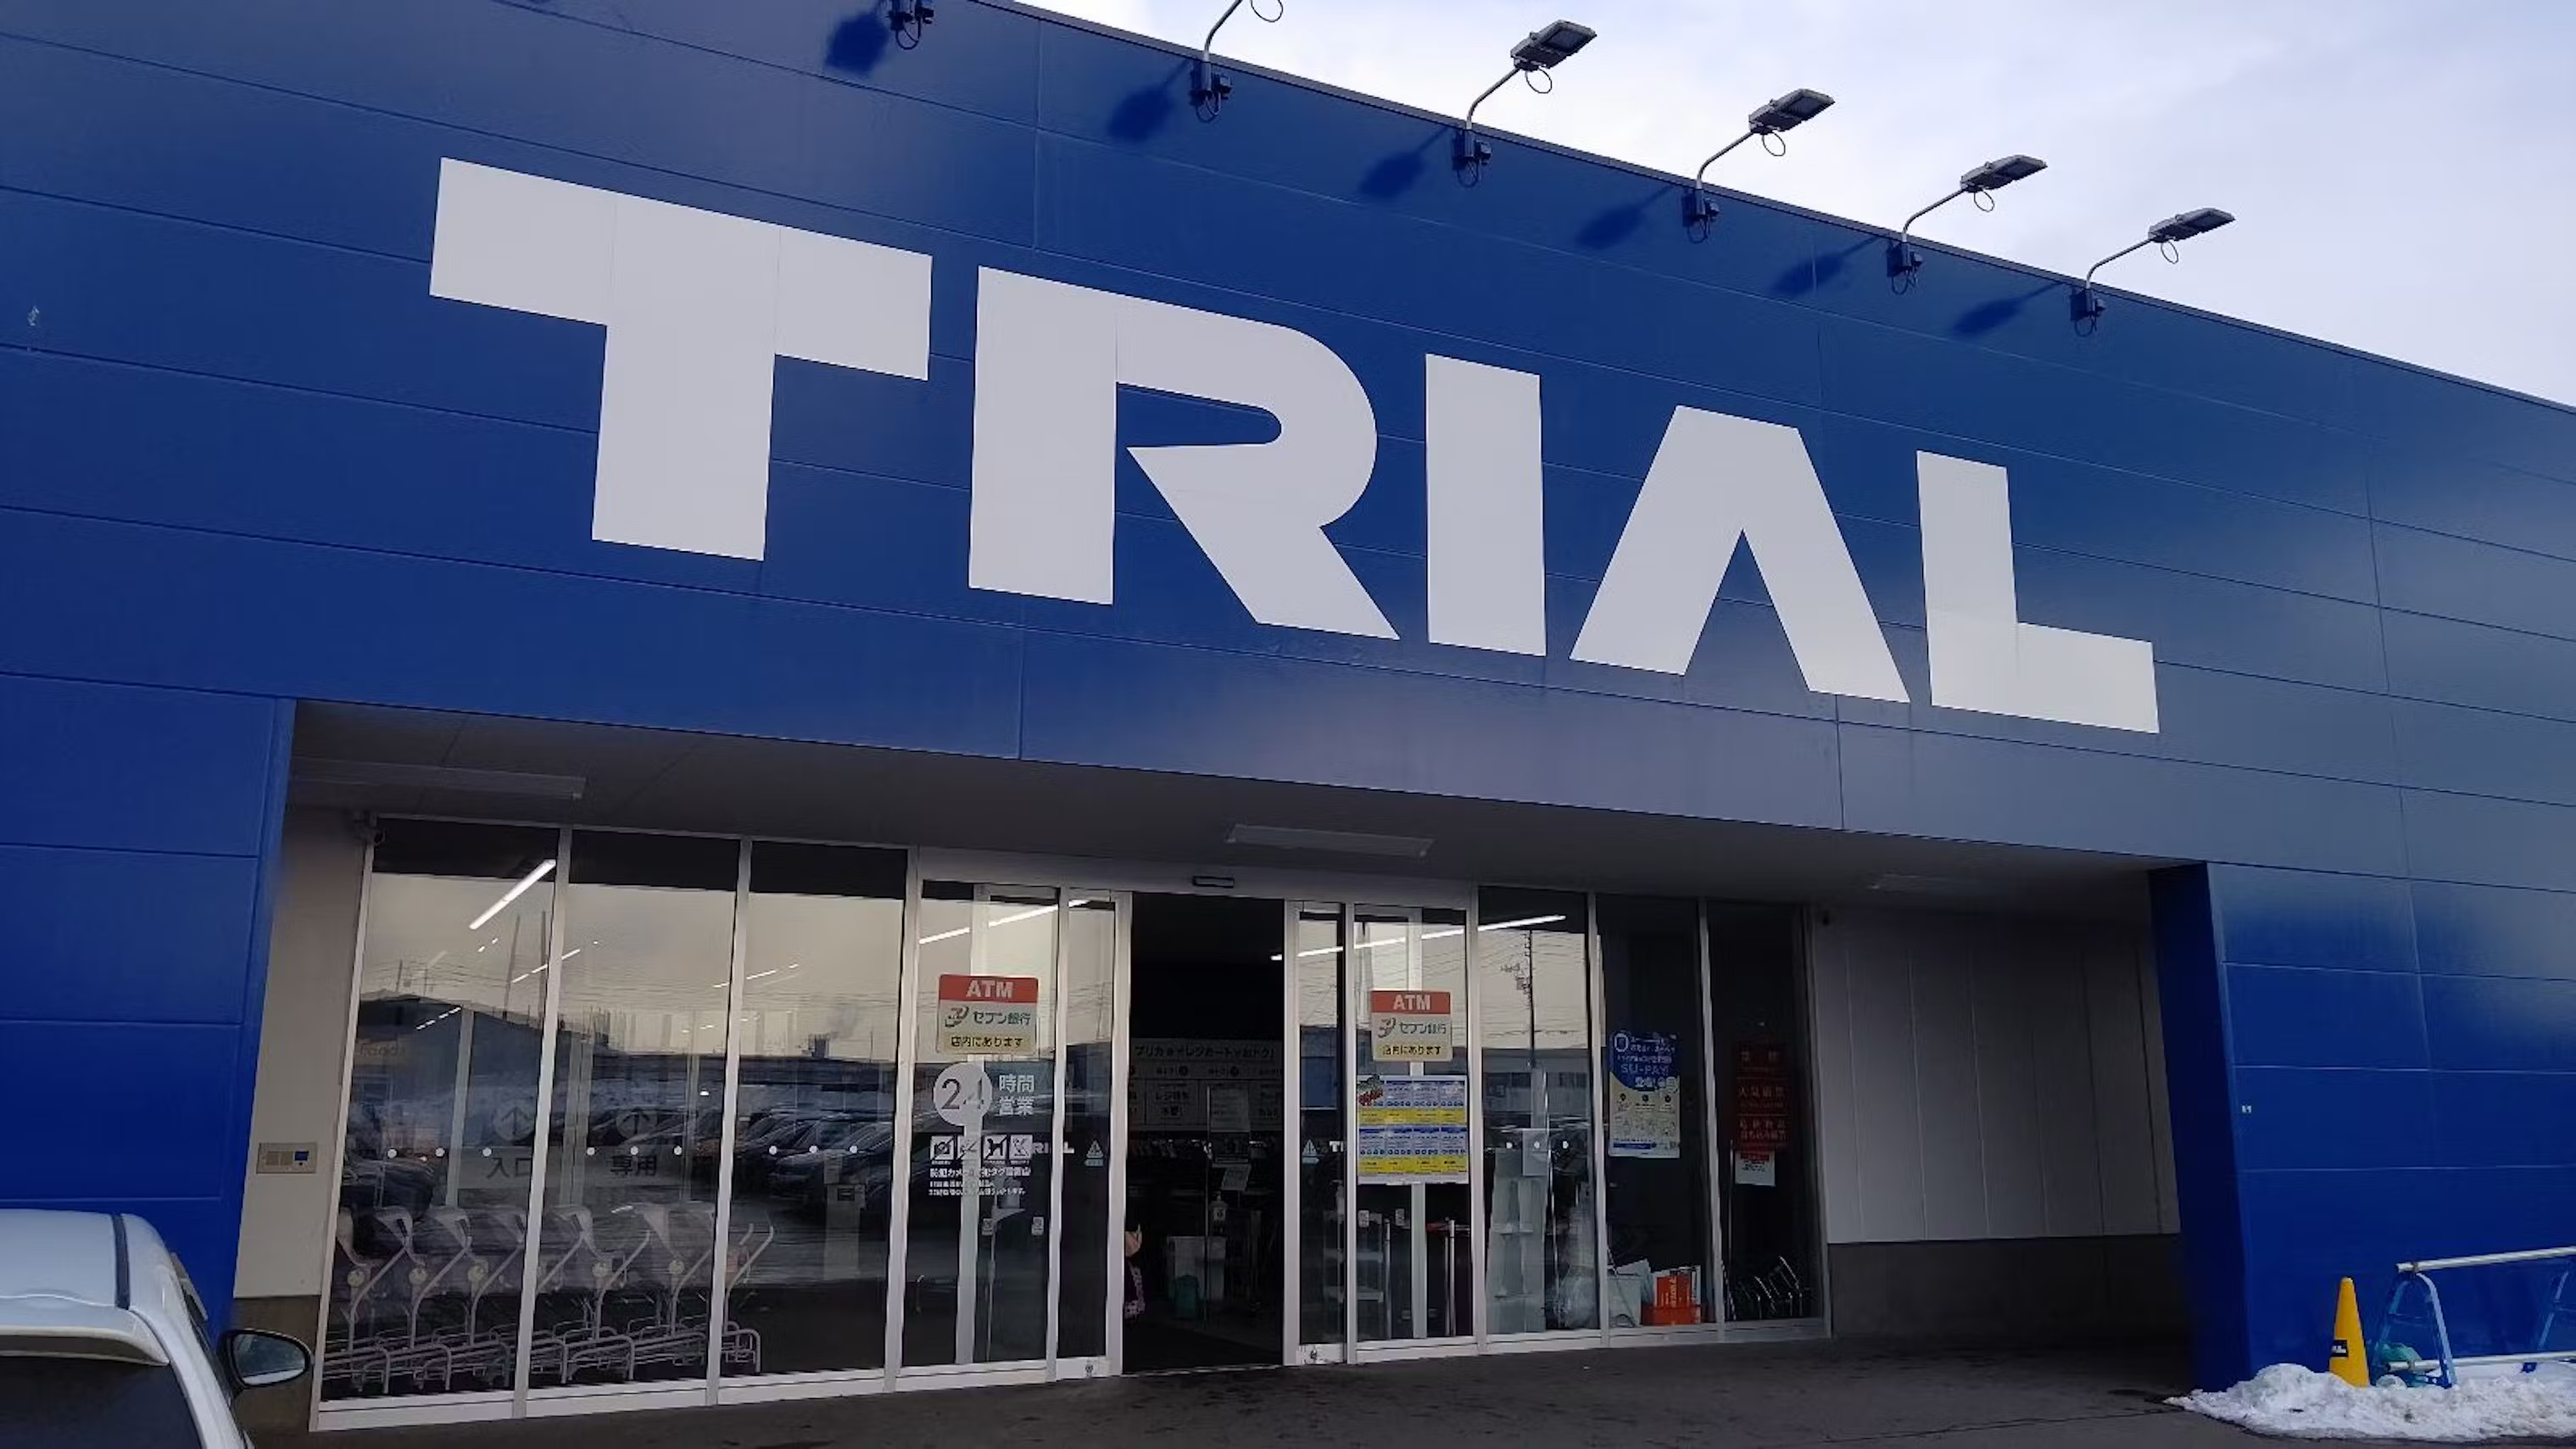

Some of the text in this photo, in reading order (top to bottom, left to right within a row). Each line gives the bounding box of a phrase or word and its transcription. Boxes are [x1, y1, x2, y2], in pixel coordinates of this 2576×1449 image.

[429, 158, 2160, 734] TRIAL
[966, 979, 1013, 999] ATM
[1393, 994, 1431, 1011] ATM
[973, 1011, 1031, 1026] セブン銀行
[1399, 1022, 1447, 1034] セブン銀行
[951, 1036, 1023, 1047] 店内にあります
[999, 1073, 1035, 1093] 時間
[997, 1095, 1035, 1116] 営業
